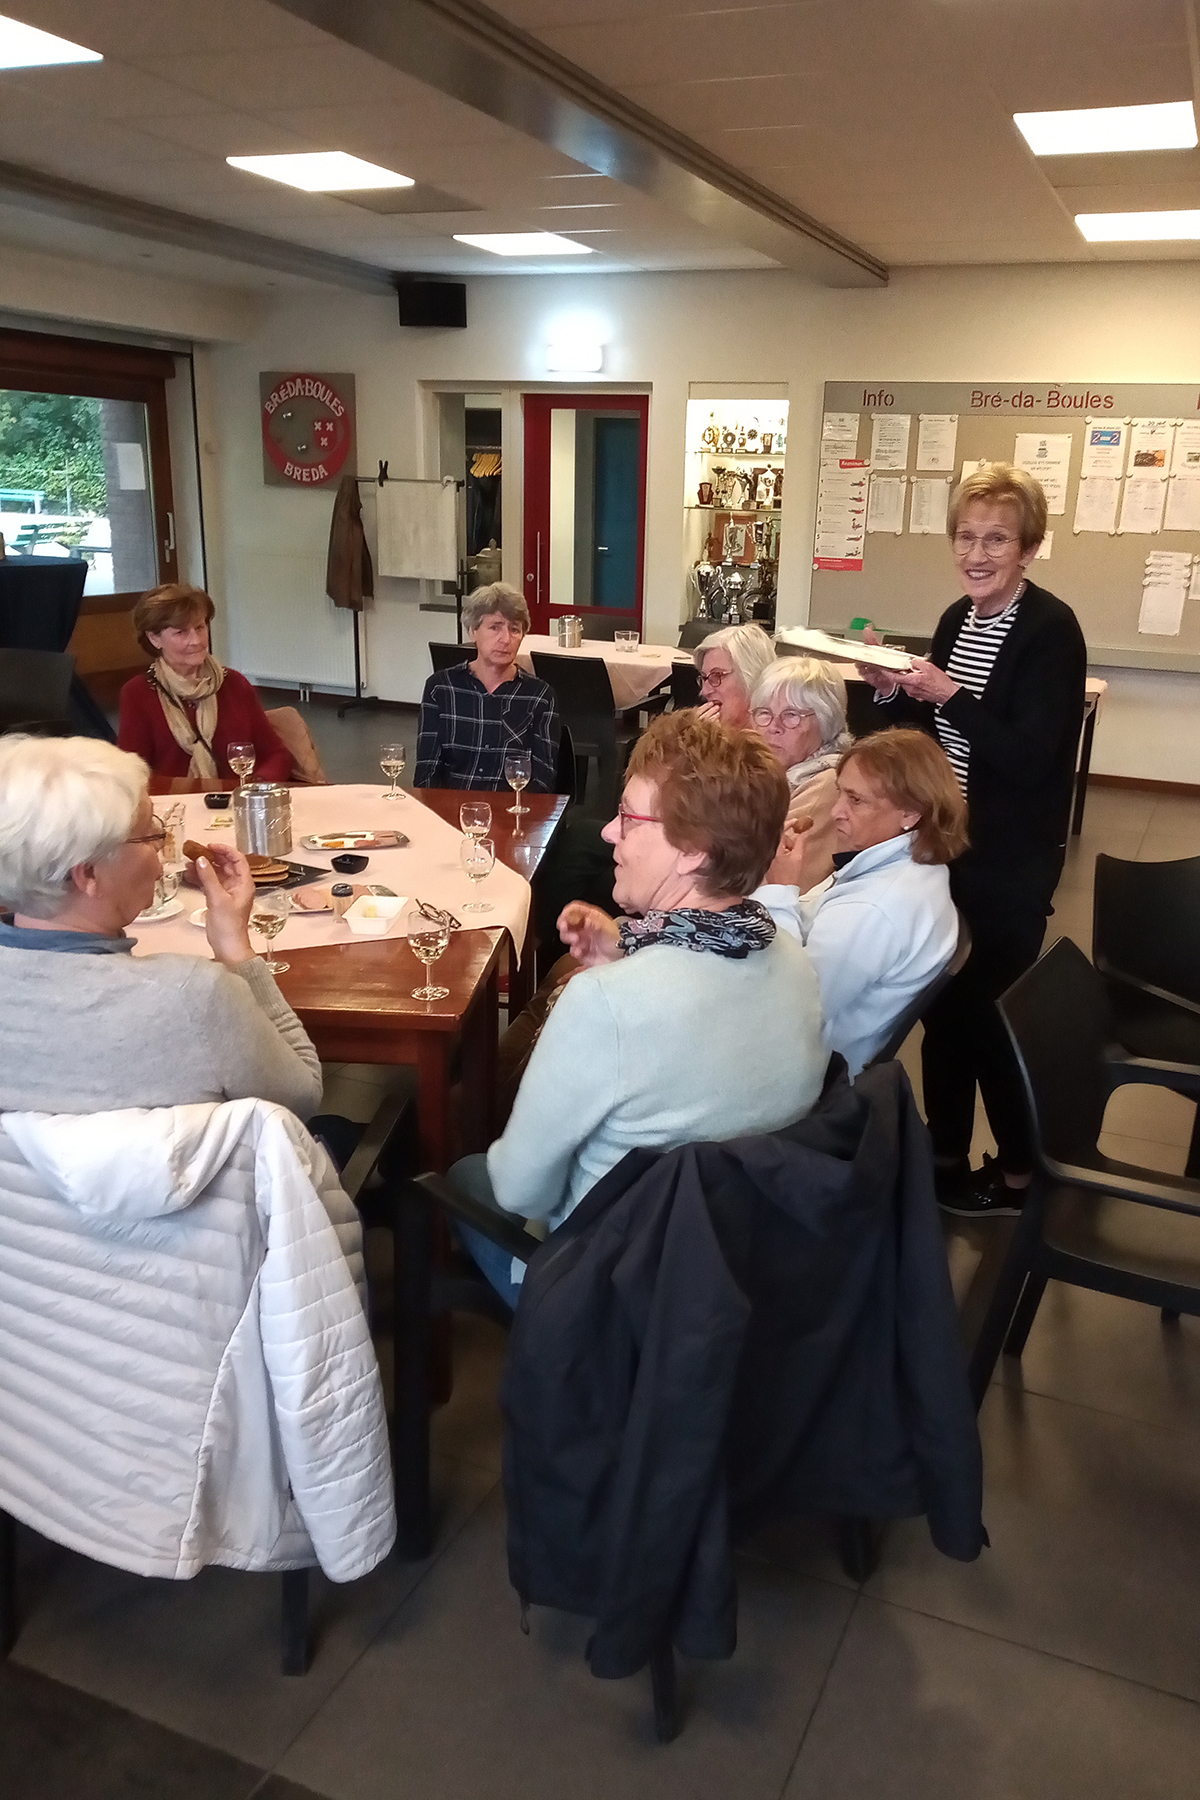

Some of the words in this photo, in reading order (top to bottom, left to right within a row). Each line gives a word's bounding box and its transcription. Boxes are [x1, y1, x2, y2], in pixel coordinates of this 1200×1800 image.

[863, 389, 895, 407] Info
[1047, 390, 1115, 409] Boules
[1092, 432, 1101, 443] 2
[1110, 432, 1119, 443] 2
[284, 462, 328, 481] BREDA
